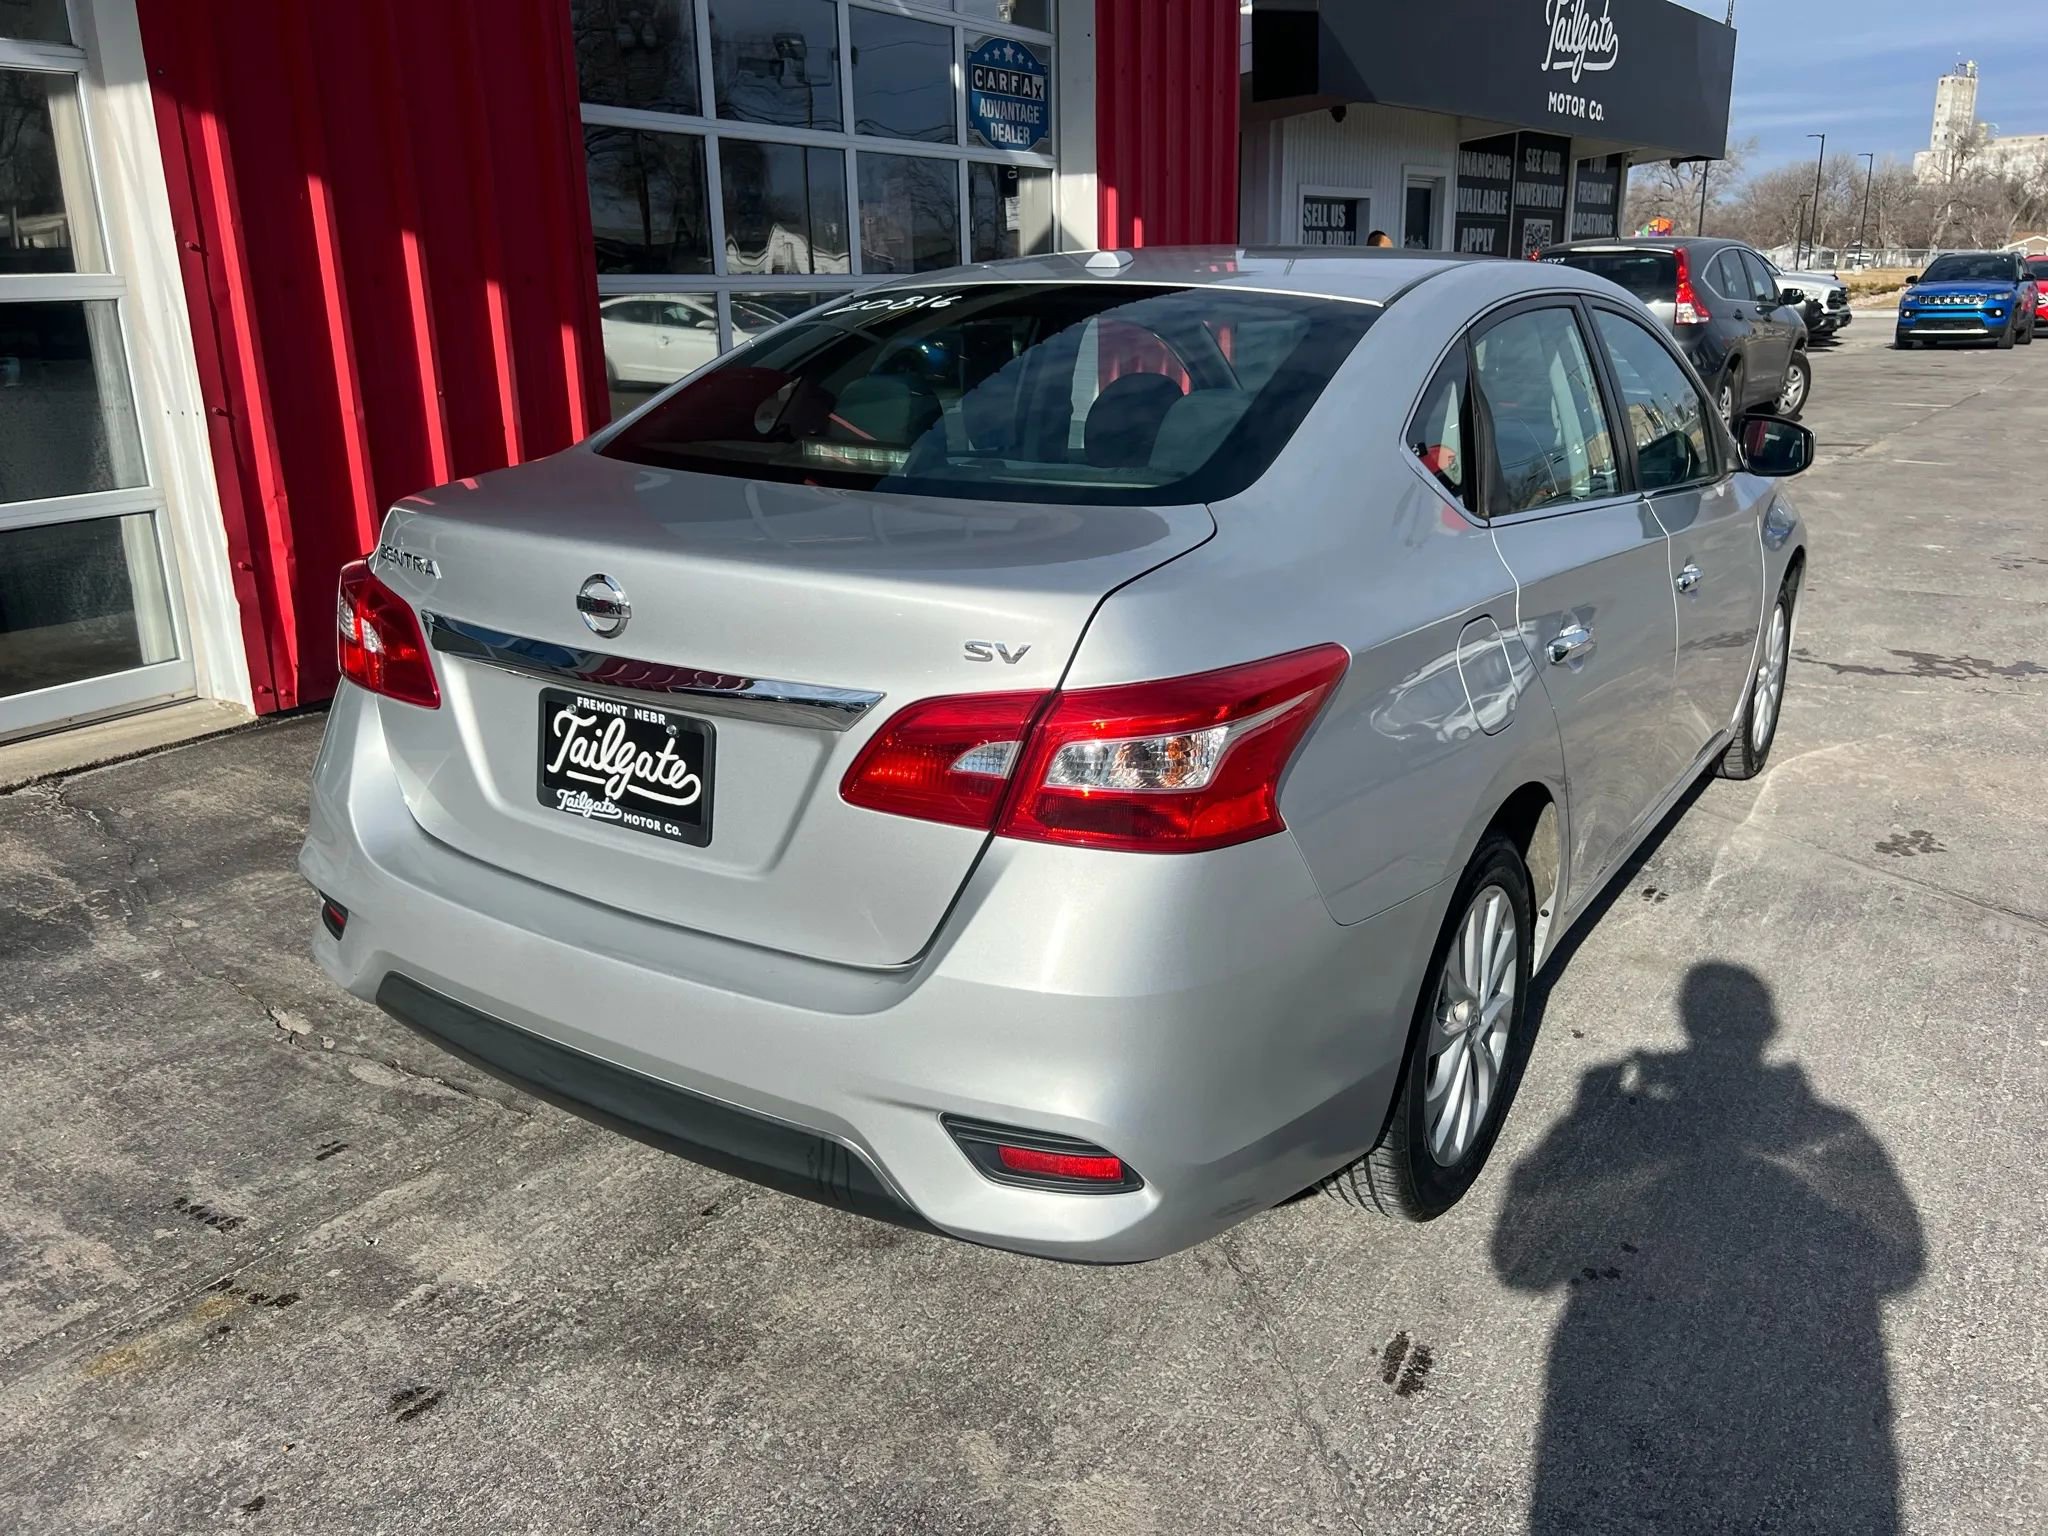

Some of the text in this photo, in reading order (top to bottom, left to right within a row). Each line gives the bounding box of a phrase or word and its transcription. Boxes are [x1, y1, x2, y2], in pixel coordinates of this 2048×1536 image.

[1541, 0, 1618, 83] Tailgate
[974, 68, 1043, 100] CARFAX
[979, 98, 1040, 124] ADVANTAGE
[1548, 91, 1585, 118] MOTOR
[990, 122, 1030, 145] DEALER
[1458, 150, 1511, 180] INANCING
[1525, 147, 1560, 175] SEE OUR
[1516, 181, 1565, 208] INVENTORY
[1578, 181, 1613, 204] FREMONT
[1304, 203, 1345, 228] SELL US
[1572, 212, 1613, 235] LOCATIONS
[1461, 227, 1495, 252] APPLY
[380, 543, 442, 579] SENTRA
[964, 640, 1031, 664] SV
[577, 696, 666, 725] FREMONT NEBR
[547, 710, 701, 806] Tailgate
[556, 788, 622, 818] Tailgate
[624, 812, 661, 832] MOTOR
